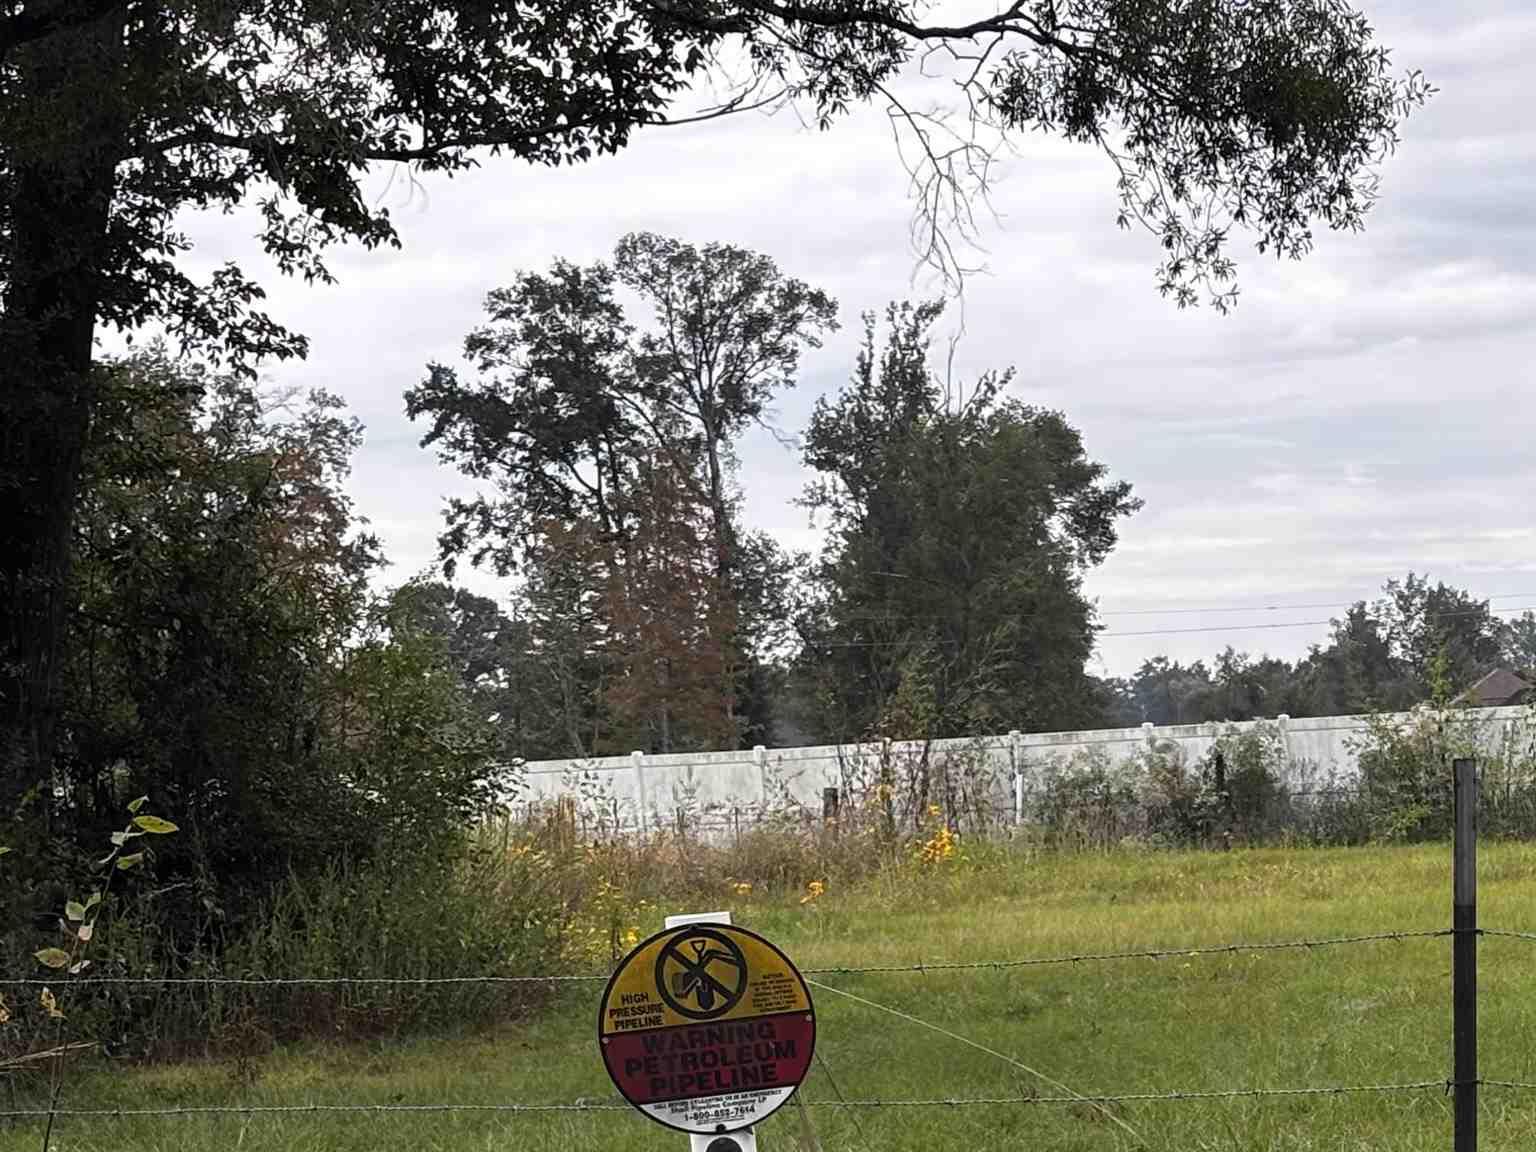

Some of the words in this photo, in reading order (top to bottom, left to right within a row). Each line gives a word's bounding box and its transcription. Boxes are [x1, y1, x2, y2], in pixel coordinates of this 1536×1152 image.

[608, 1002, 664, 1019] PRESSURE
[621, 992, 649, 1005] HIGH
[615, 1015, 664, 1030] PIPELINE
[641, 1021, 776, 1053] WARNING
[624, 1039, 796, 1077] PETROLEUM
[652, 1062, 778, 1095] PIPELINE
